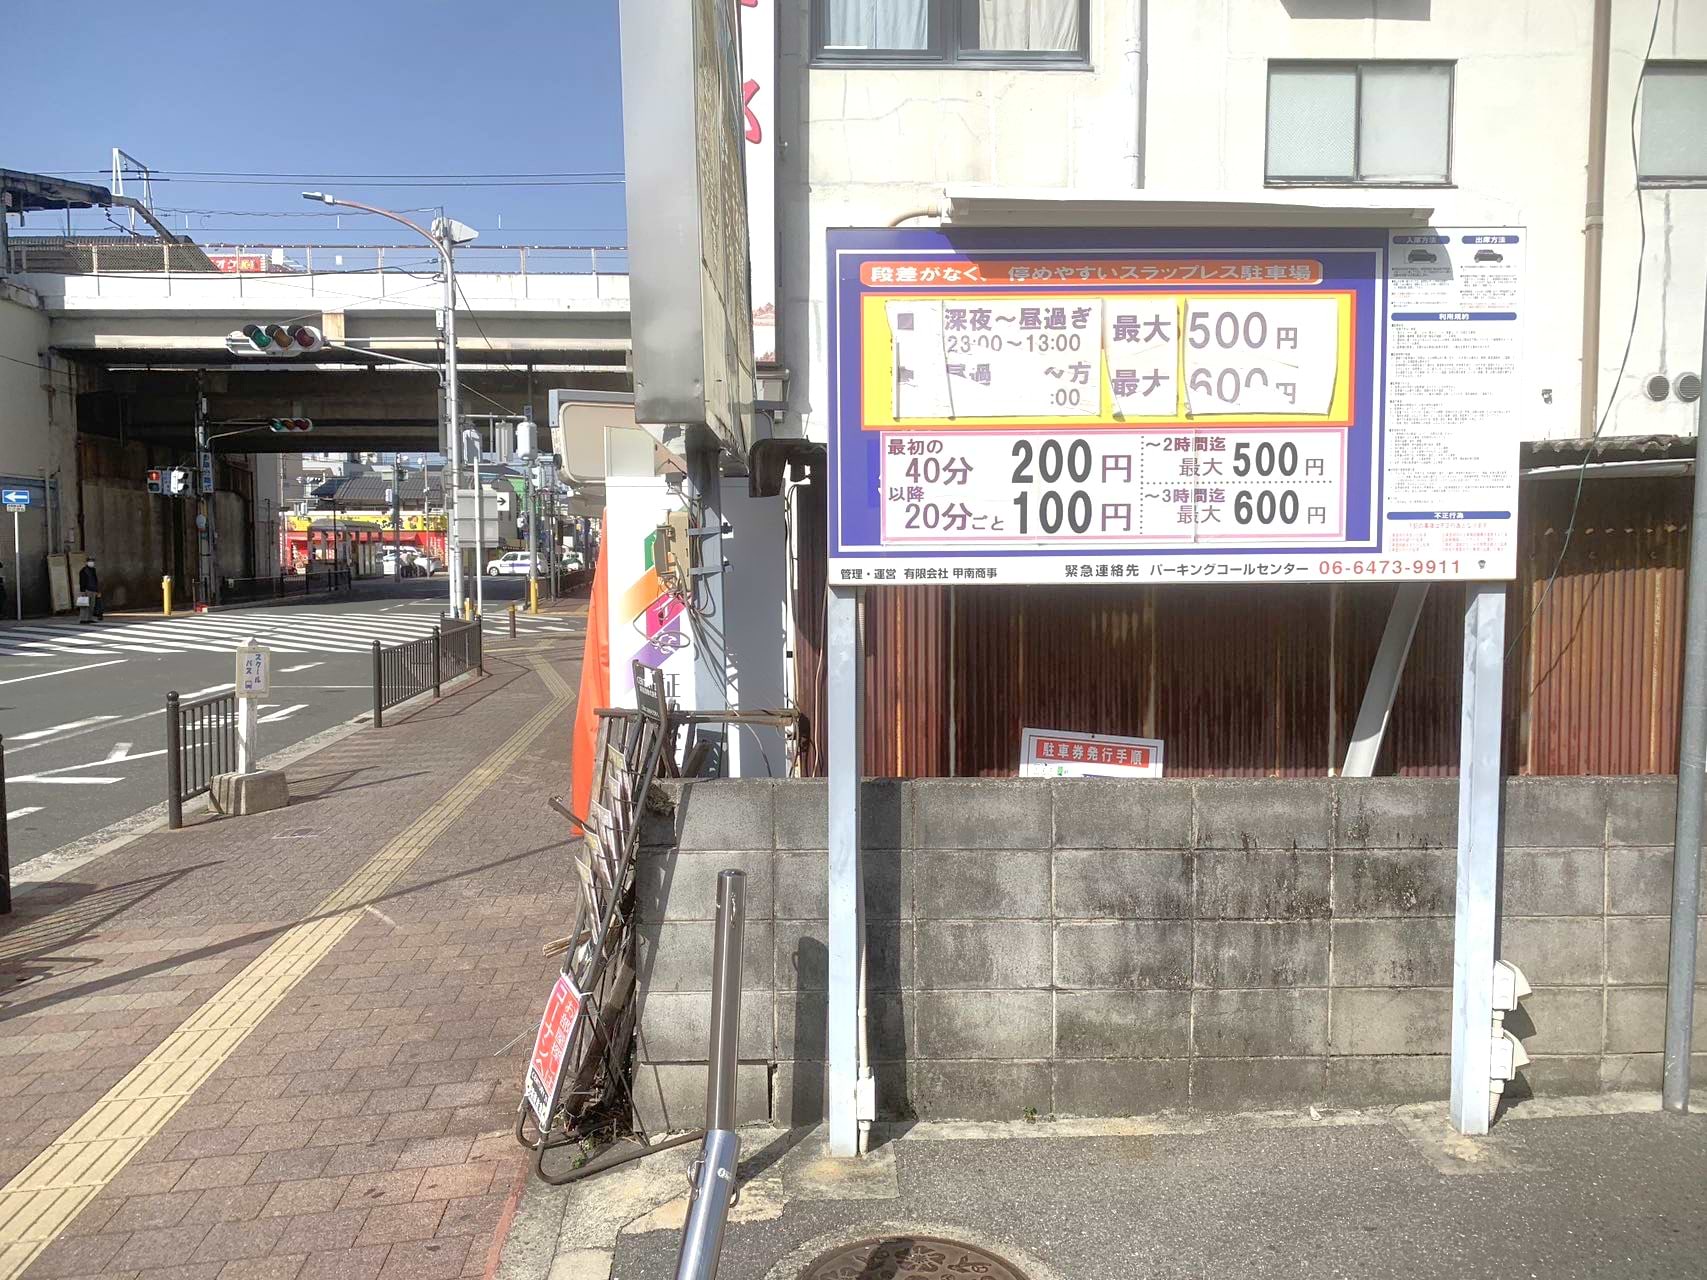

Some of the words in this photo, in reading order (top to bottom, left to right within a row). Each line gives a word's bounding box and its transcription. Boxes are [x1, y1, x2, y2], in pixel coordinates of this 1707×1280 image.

[870, 266, 988, 282] 段差がなく、
[1113, 314, 1171, 342] 最大
[1112, 368, 1170, 397] 最大
[888, 438, 943, 456] 最初の
[905, 456, 974, 486] 40分
[1179, 457, 1224, 477] 最大
[888, 486, 925, 502] 以降
[905, 502, 1005, 532] 20分ごと
[1177, 505, 1221, 524] 最大
[840, 568, 896, 580] 管理・運営
[904, 568, 949, 580] 有限会社
[953, 567, 998, 579] 甲南商事
[1065, 564, 1139, 577] 緊急連絡先
[1150, 562, 1309, 577] パーキングコールセンター
[1318, 559, 1461, 575] 06-6473-9911
[1042, 742, 1143, 766] 駐車券発行手順
